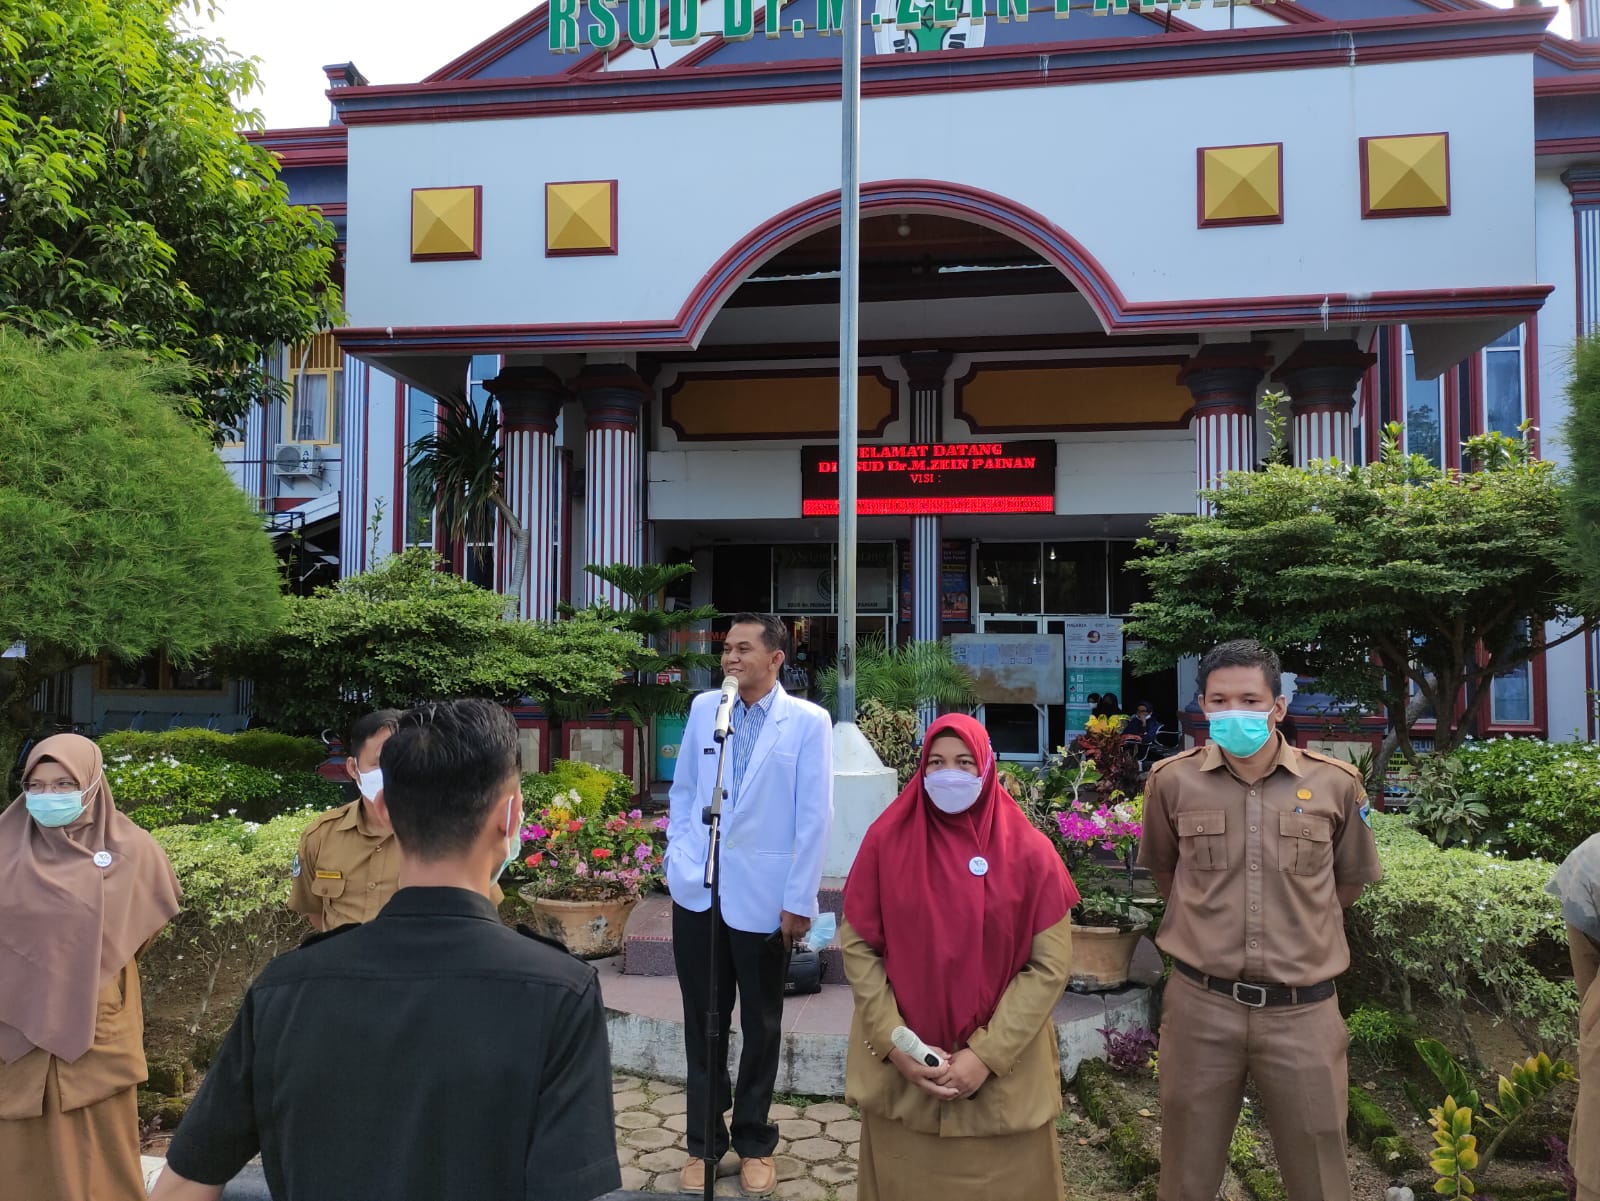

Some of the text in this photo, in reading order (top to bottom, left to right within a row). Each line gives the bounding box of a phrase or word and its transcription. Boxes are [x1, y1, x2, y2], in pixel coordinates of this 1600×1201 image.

[549, 0, 699, 53] RSUD
[857, 444, 1002, 458] ELAMAT DATANG
[818, 462, 838, 472] DI
[856, 460, 884, 472] SUD
[972, 457, 1036, 469] PAINAN
[910, 474, 934, 484] VISI
